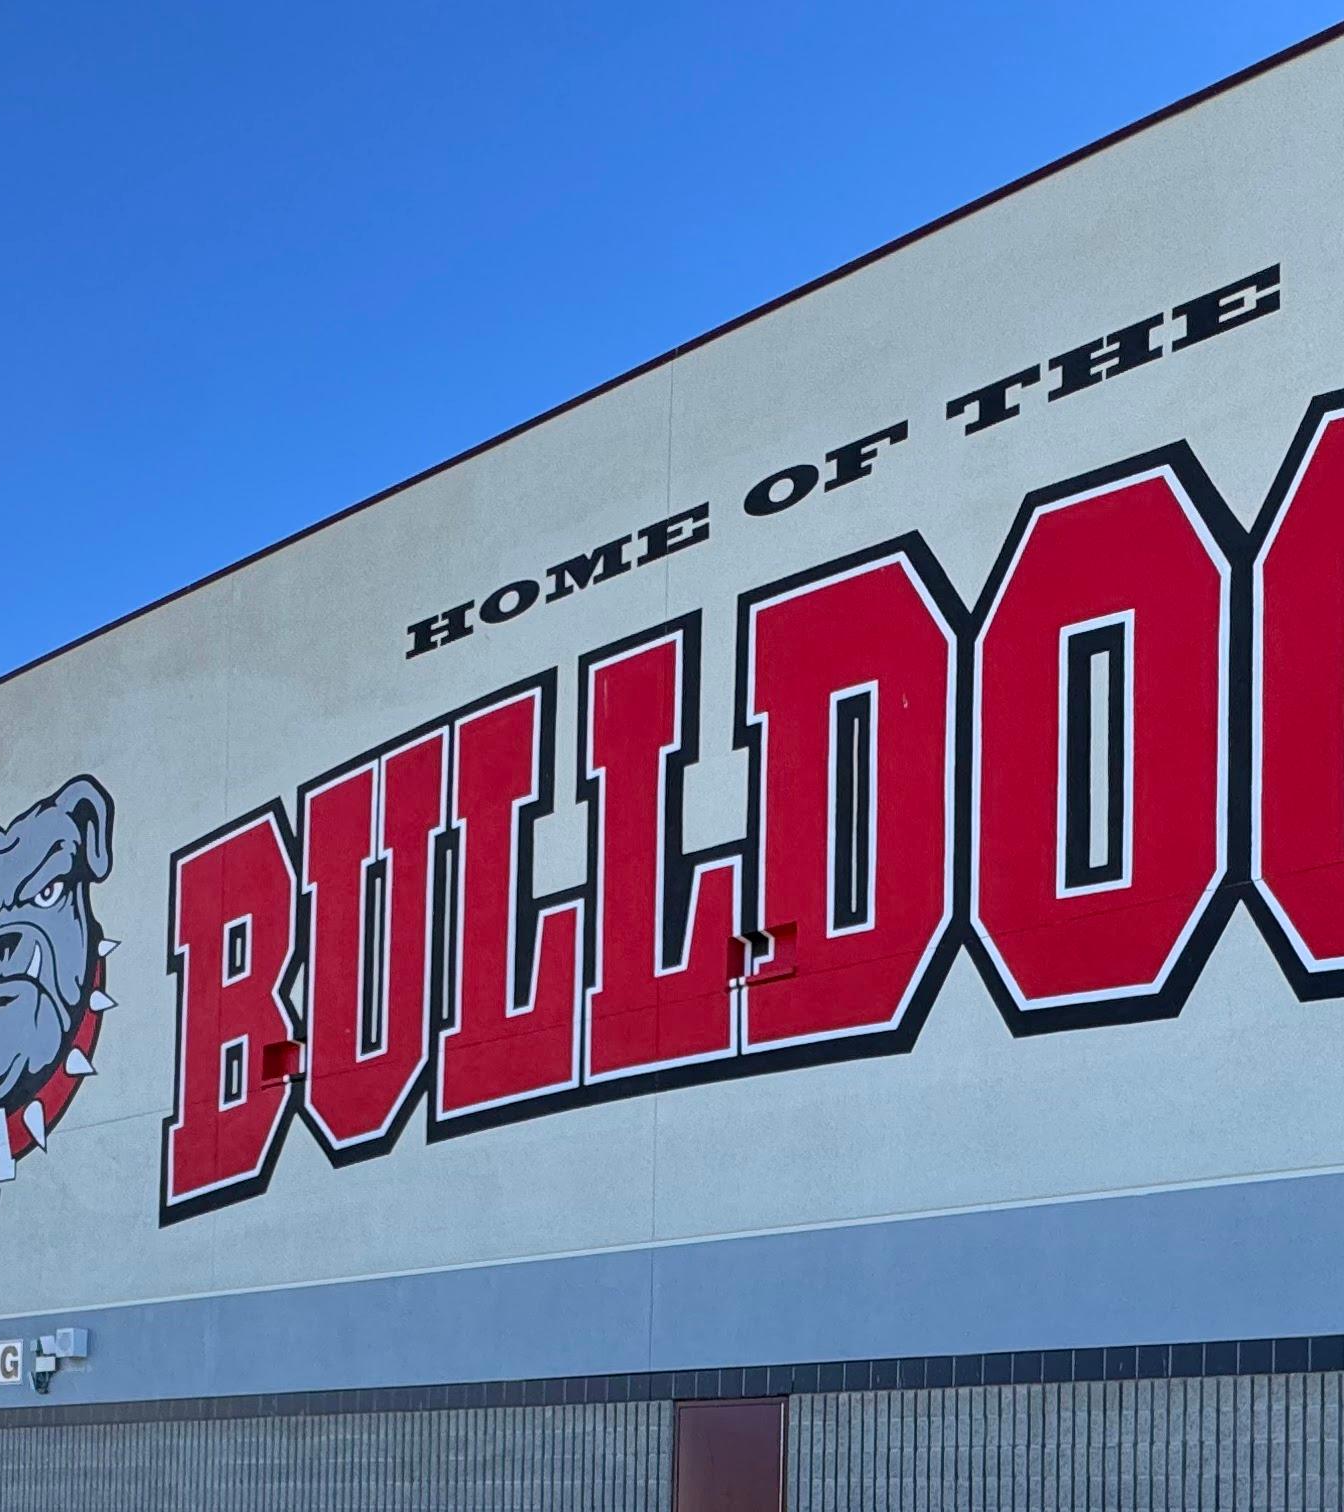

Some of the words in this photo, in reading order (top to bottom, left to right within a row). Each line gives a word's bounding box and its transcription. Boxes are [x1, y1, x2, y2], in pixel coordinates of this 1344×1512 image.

[406, 502, 711, 661] HOME
[744, 419, 909, 518] OF
[946, 262, 1281, 437] THE
[0, 1345, 19, 1379] G
